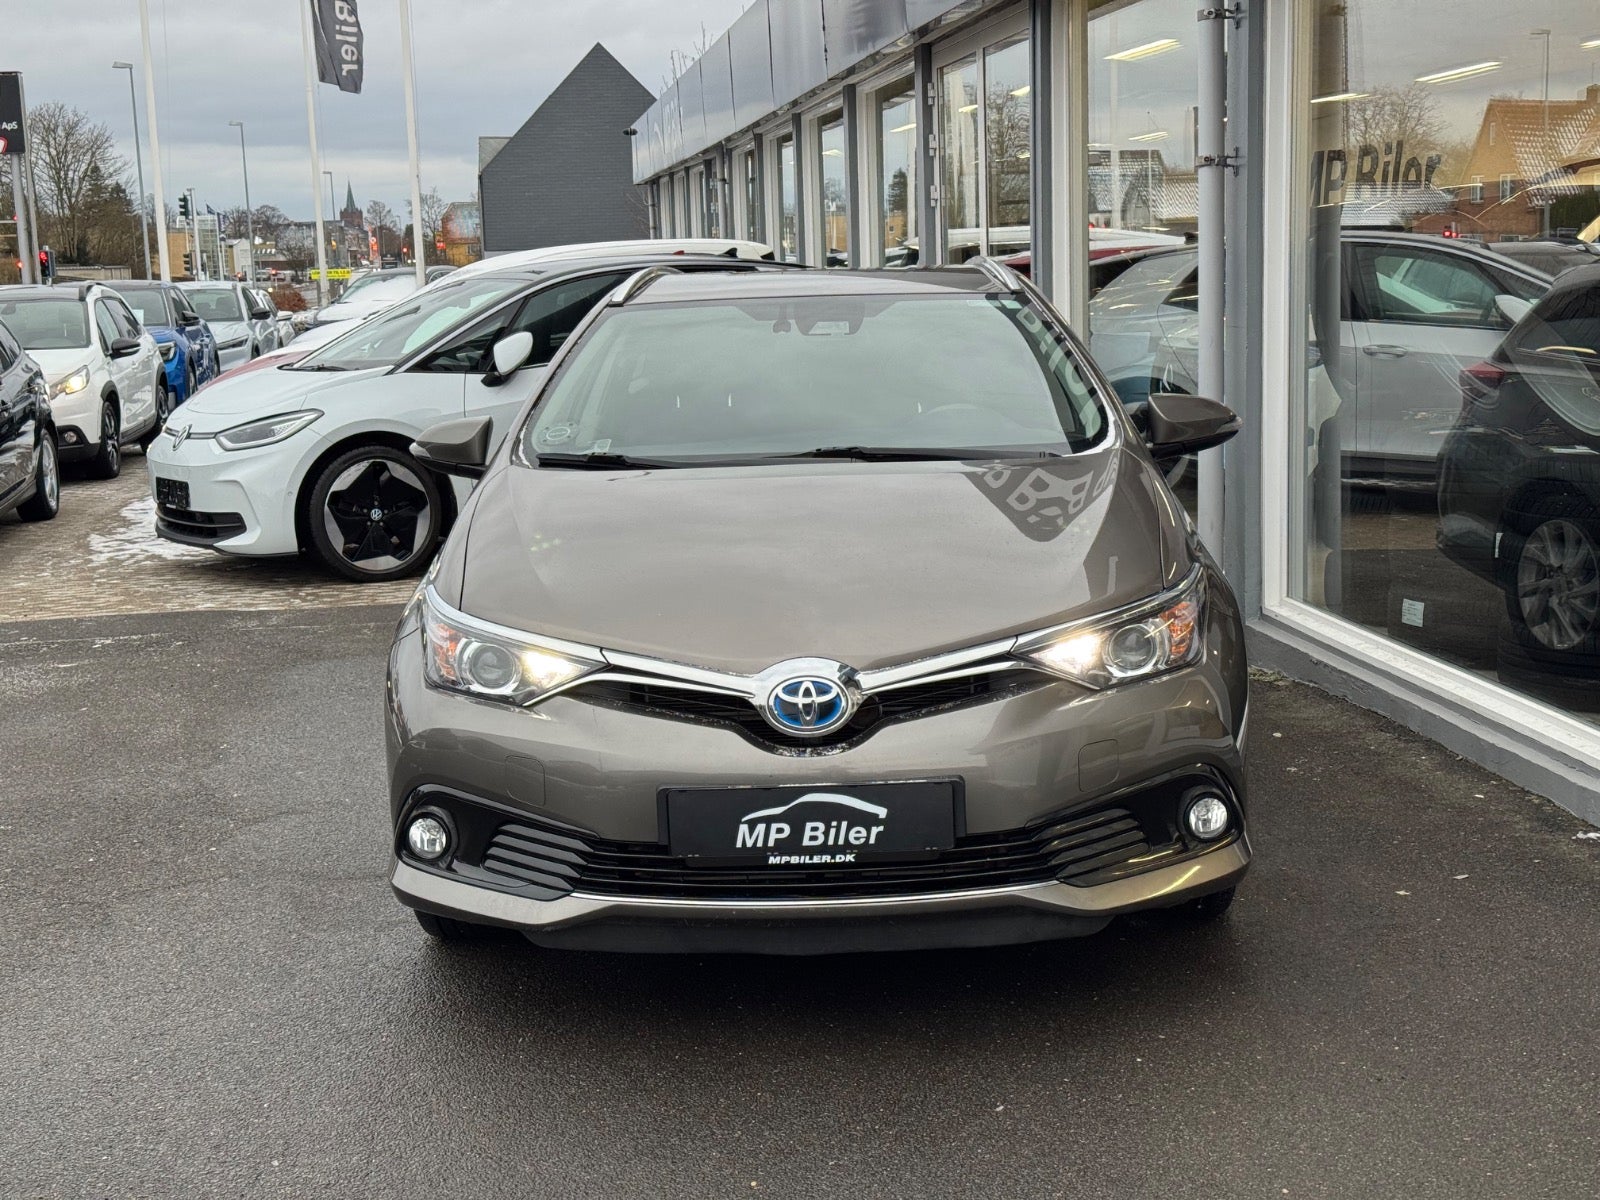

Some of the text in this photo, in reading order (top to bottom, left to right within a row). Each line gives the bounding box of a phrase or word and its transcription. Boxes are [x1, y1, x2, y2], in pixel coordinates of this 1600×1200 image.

[2, 121, 18, 131] ApS
[736, 820, 885, 848] MP Biler
[768, 853, 857, 865] MPBILER.DK
